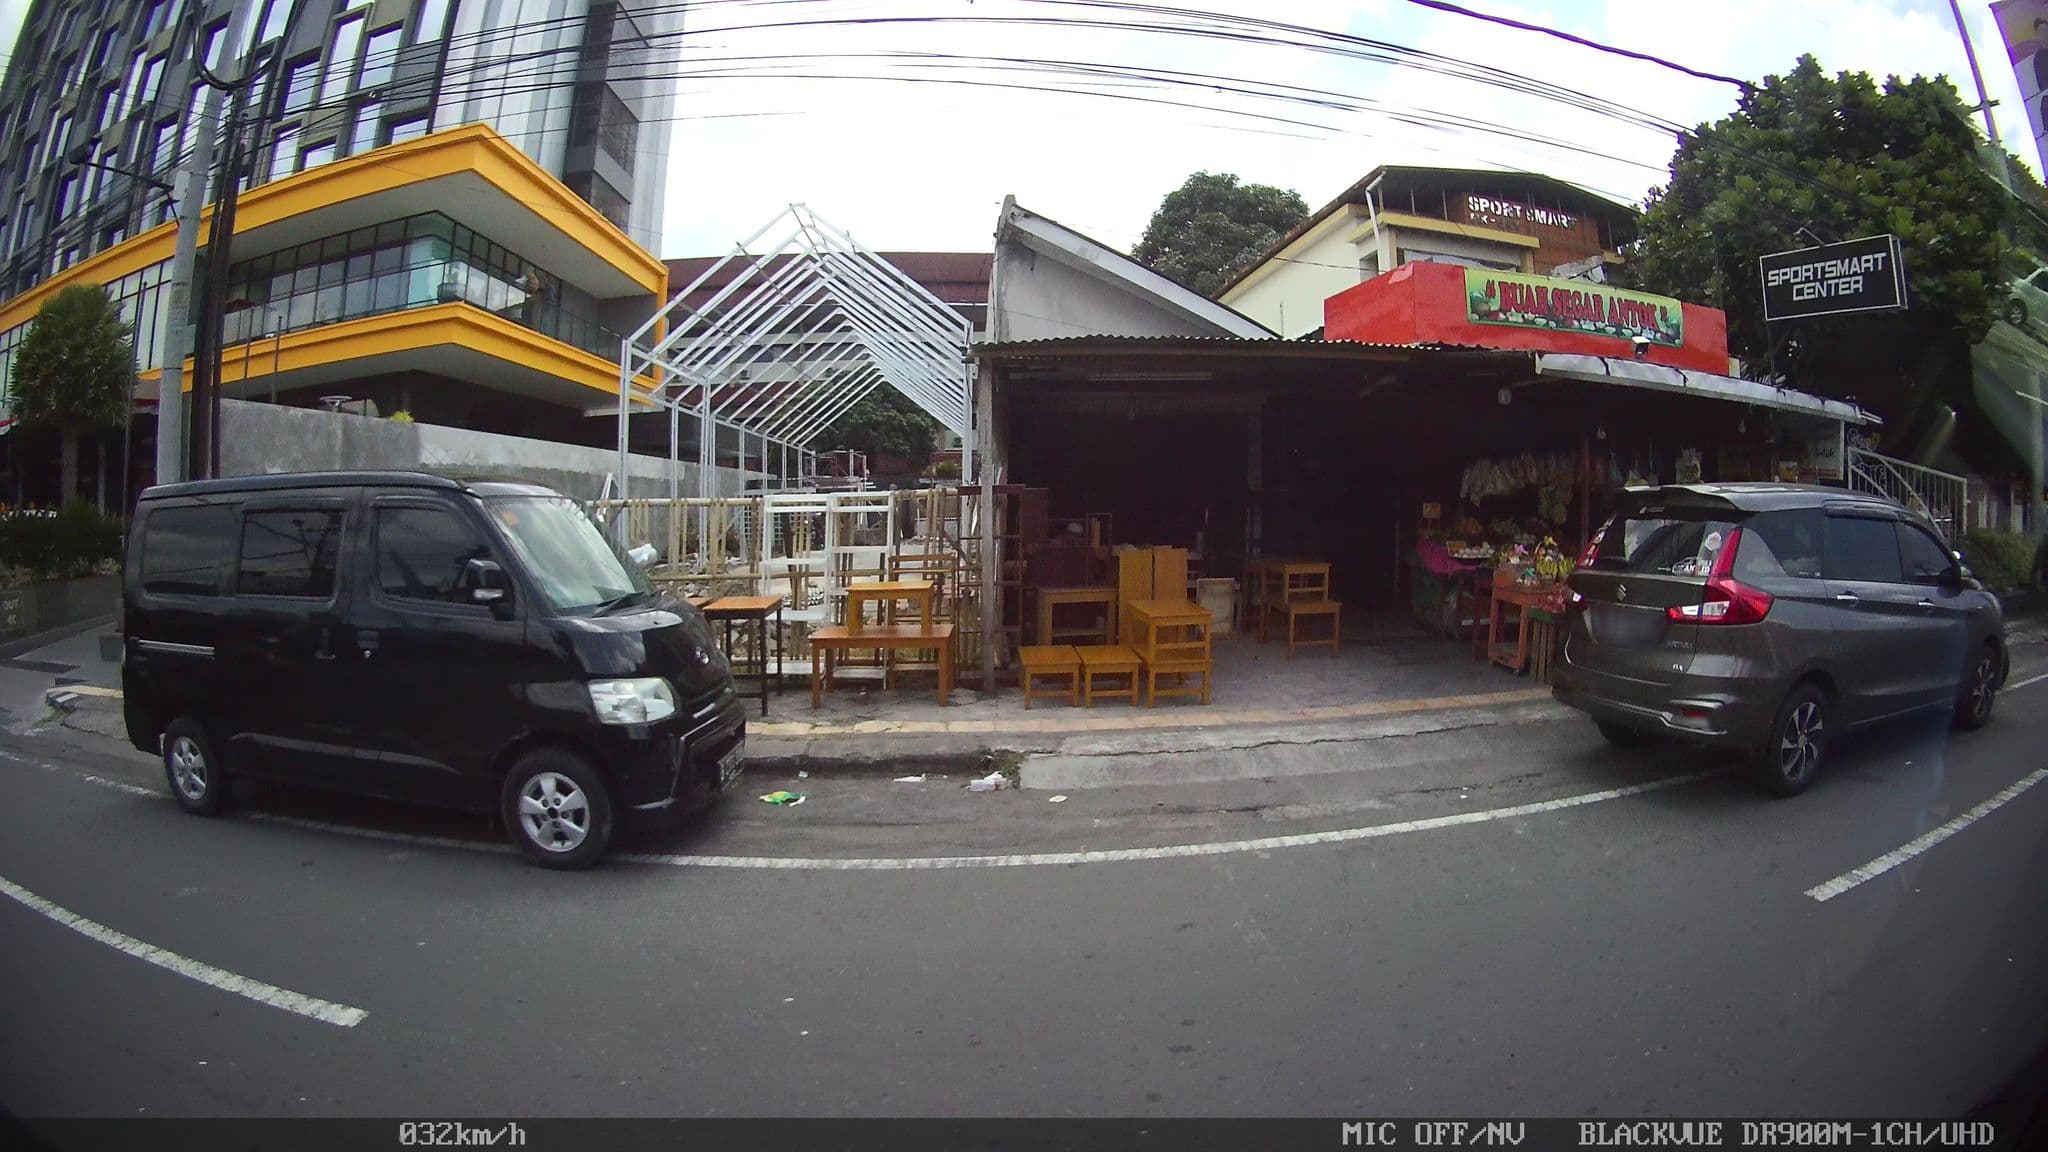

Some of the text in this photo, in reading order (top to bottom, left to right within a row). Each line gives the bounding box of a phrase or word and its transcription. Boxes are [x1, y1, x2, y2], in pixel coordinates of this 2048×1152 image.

[1468, 196, 1522, 218] SPORT
[1767, 252, 1887, 287] SPORTSMART
[1792, 275, 1863, 301] CENTER
[1498, 282, 1549, 315] BUAH
[1551, 288, 1604, 323] SEGAR
[3, 599, 20, 610] OUT
